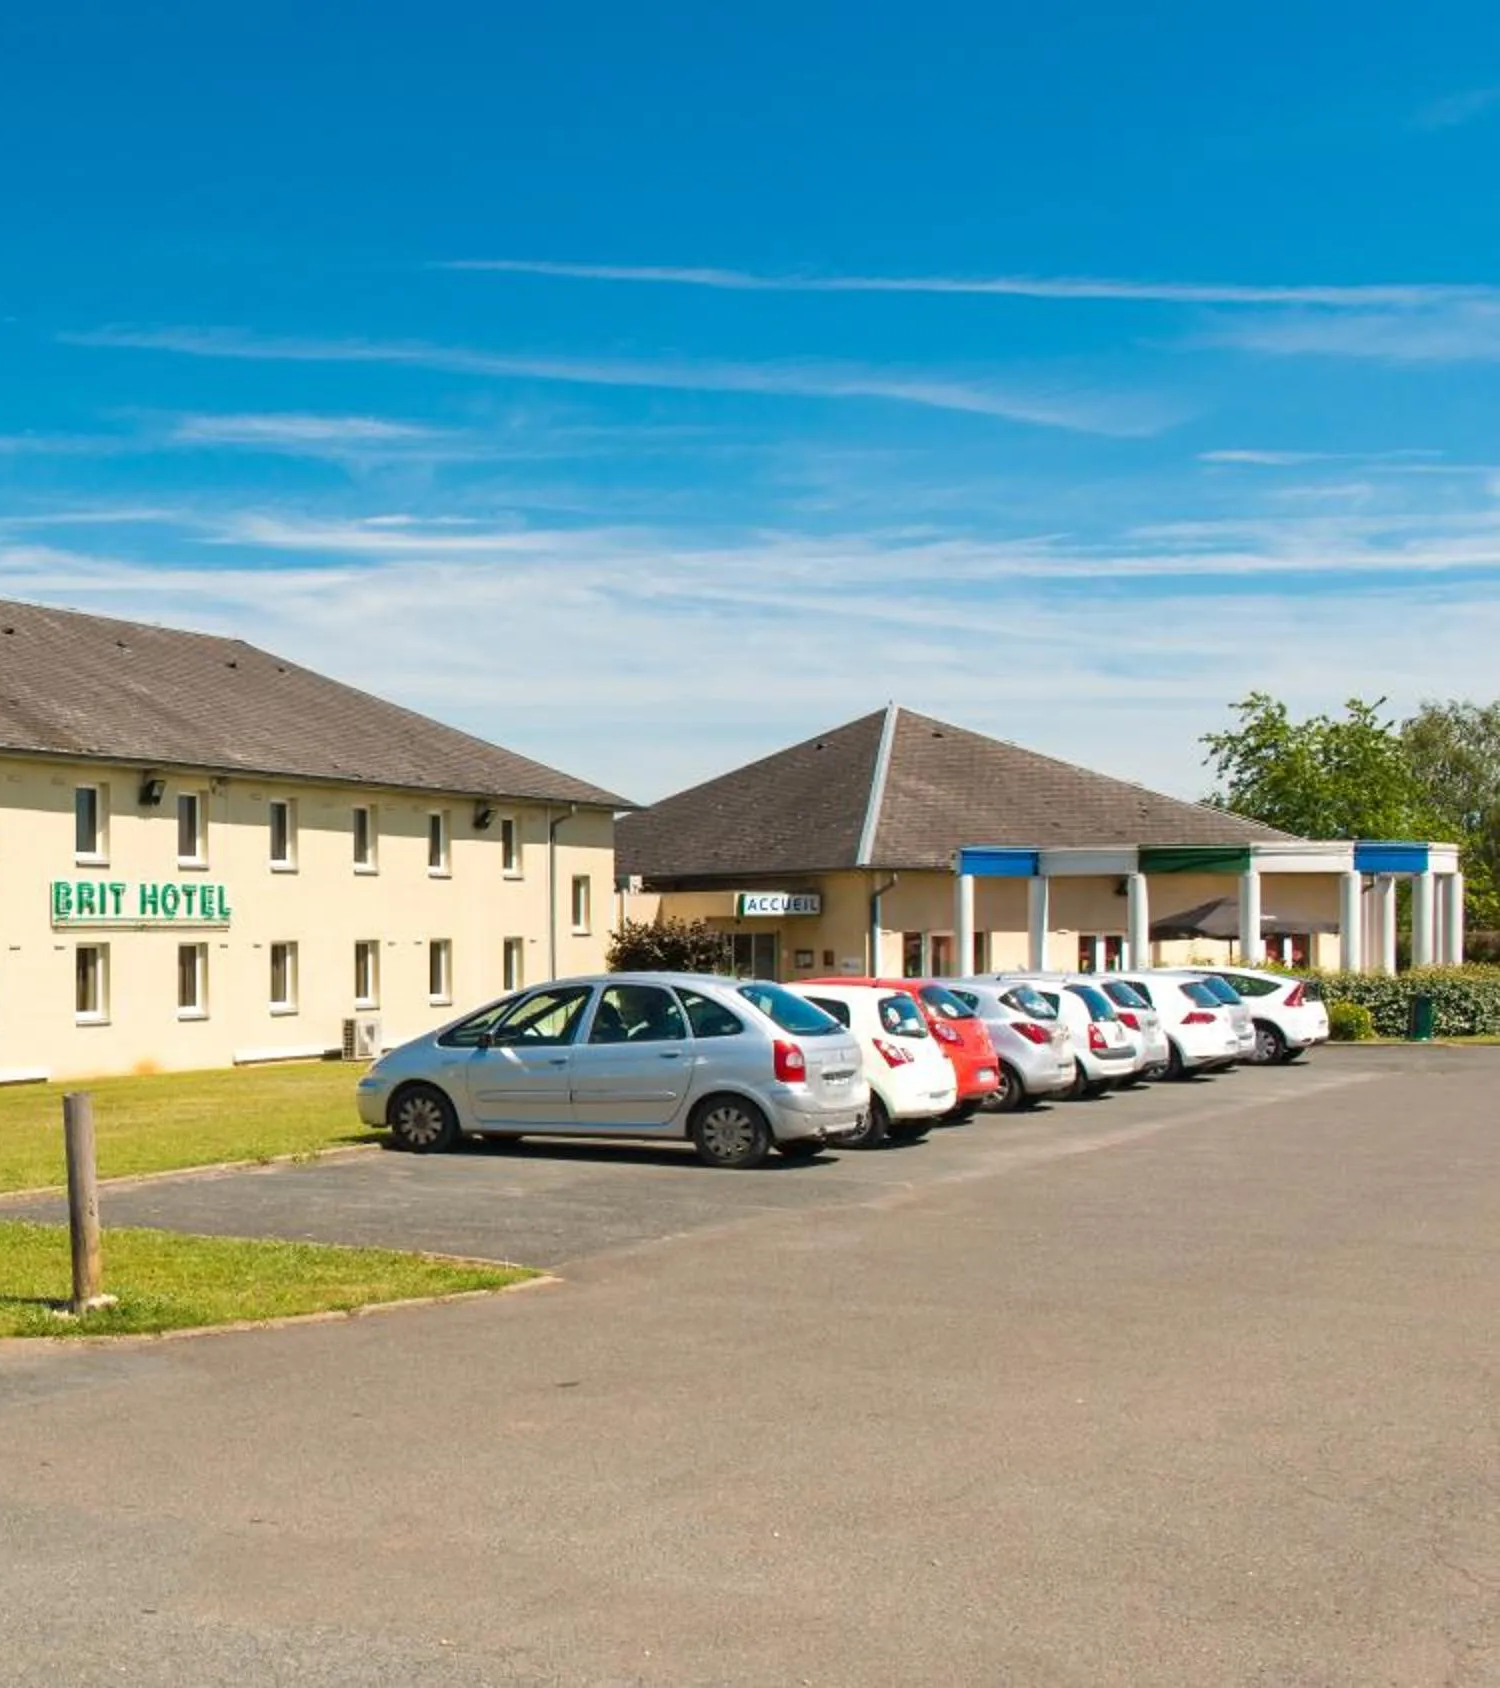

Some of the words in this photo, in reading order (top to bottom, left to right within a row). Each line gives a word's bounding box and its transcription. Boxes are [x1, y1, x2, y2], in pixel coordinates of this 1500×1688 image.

[53, 881, 126, 916] BRIT
[139, 883, 231, 917] HOTEL
[747, 897, 818, 911] ACCUEIL
